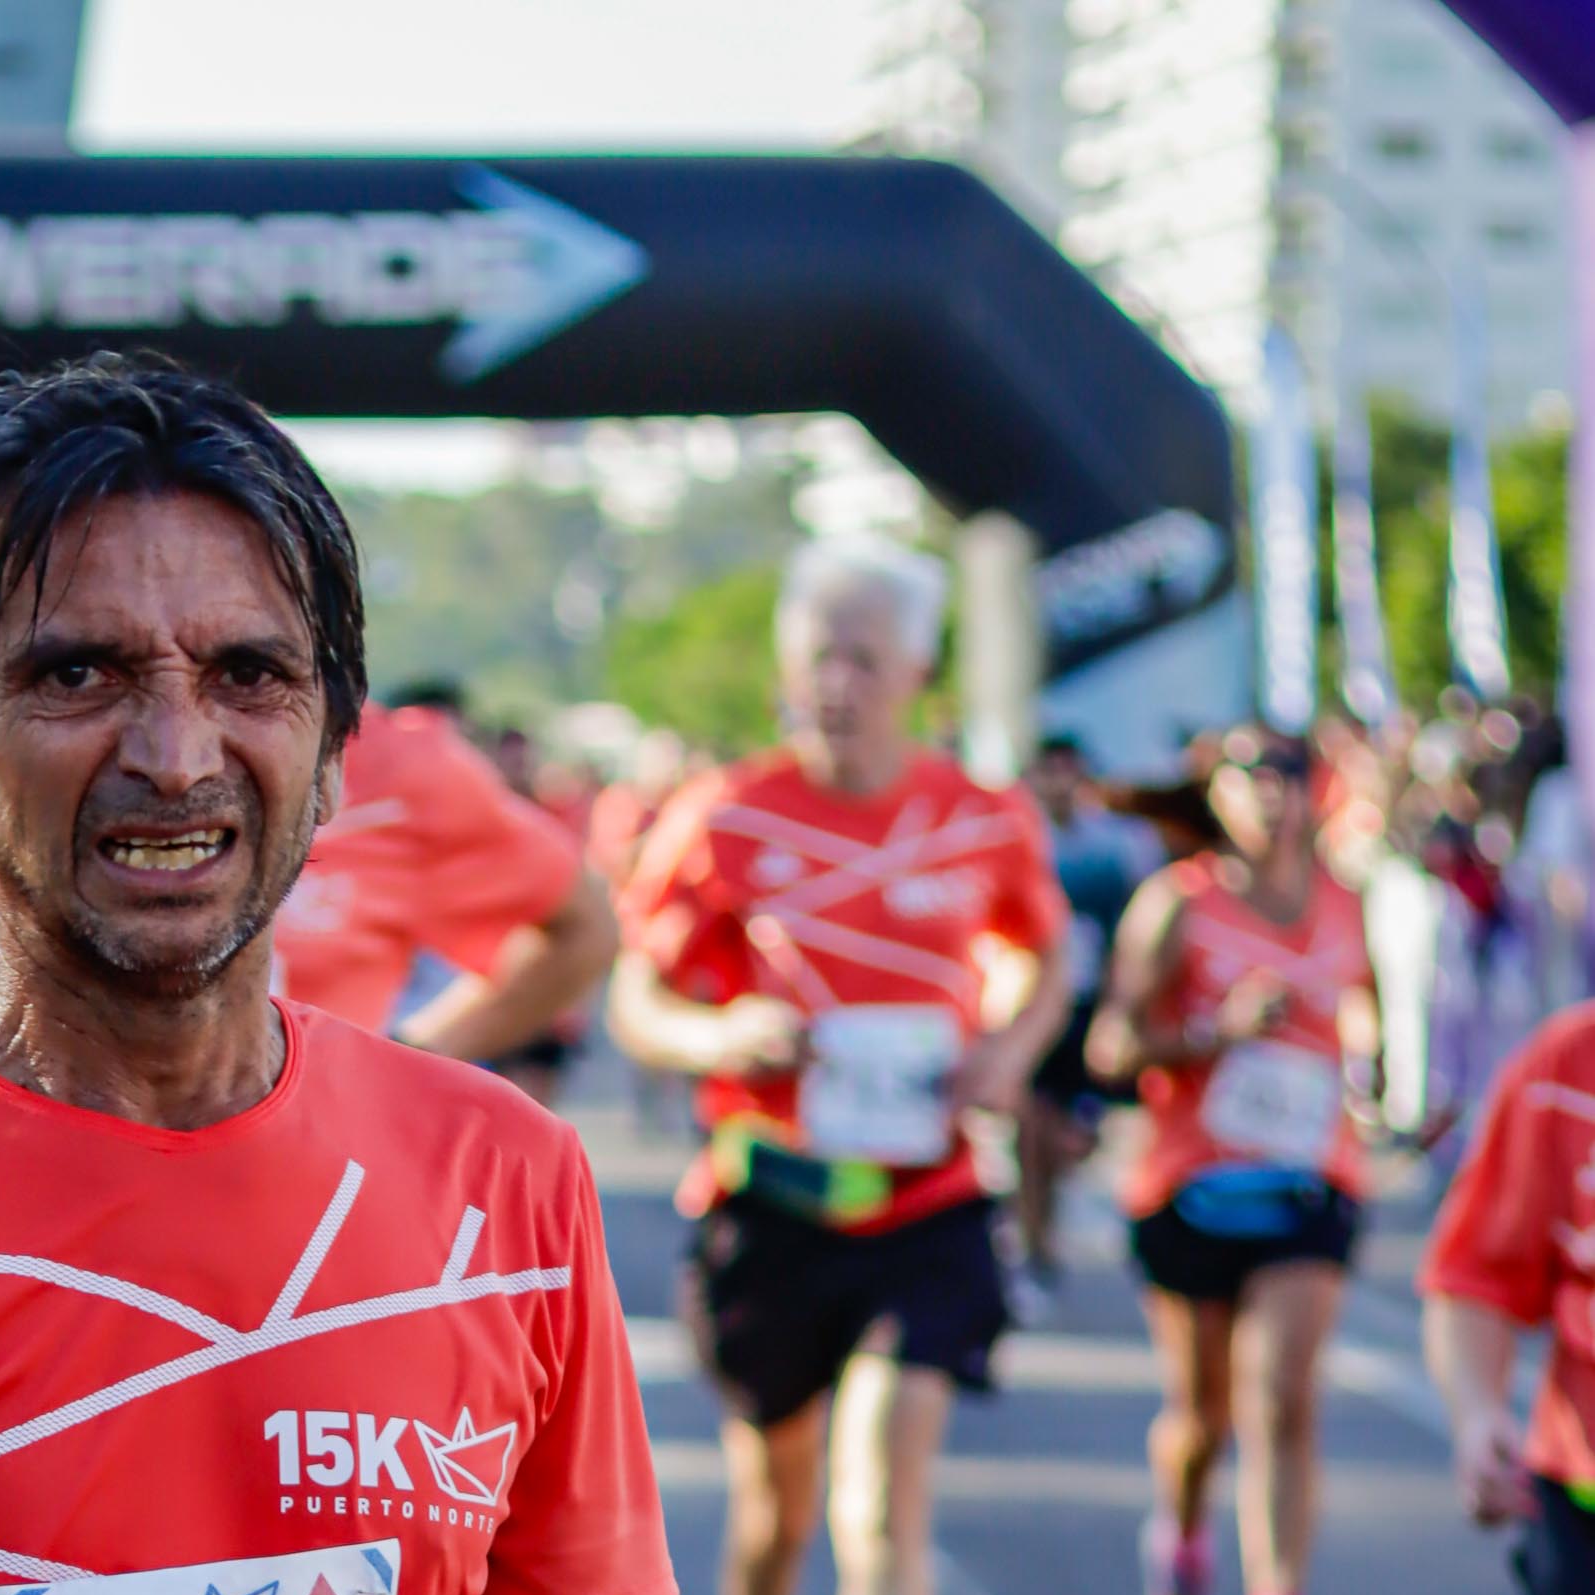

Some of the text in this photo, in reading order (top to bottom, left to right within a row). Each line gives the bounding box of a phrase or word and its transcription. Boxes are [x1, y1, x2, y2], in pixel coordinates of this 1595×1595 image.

[263, 1409, 415, 1491] 15K
[279, 1495, 496, 1535] PUERTO NORTE
